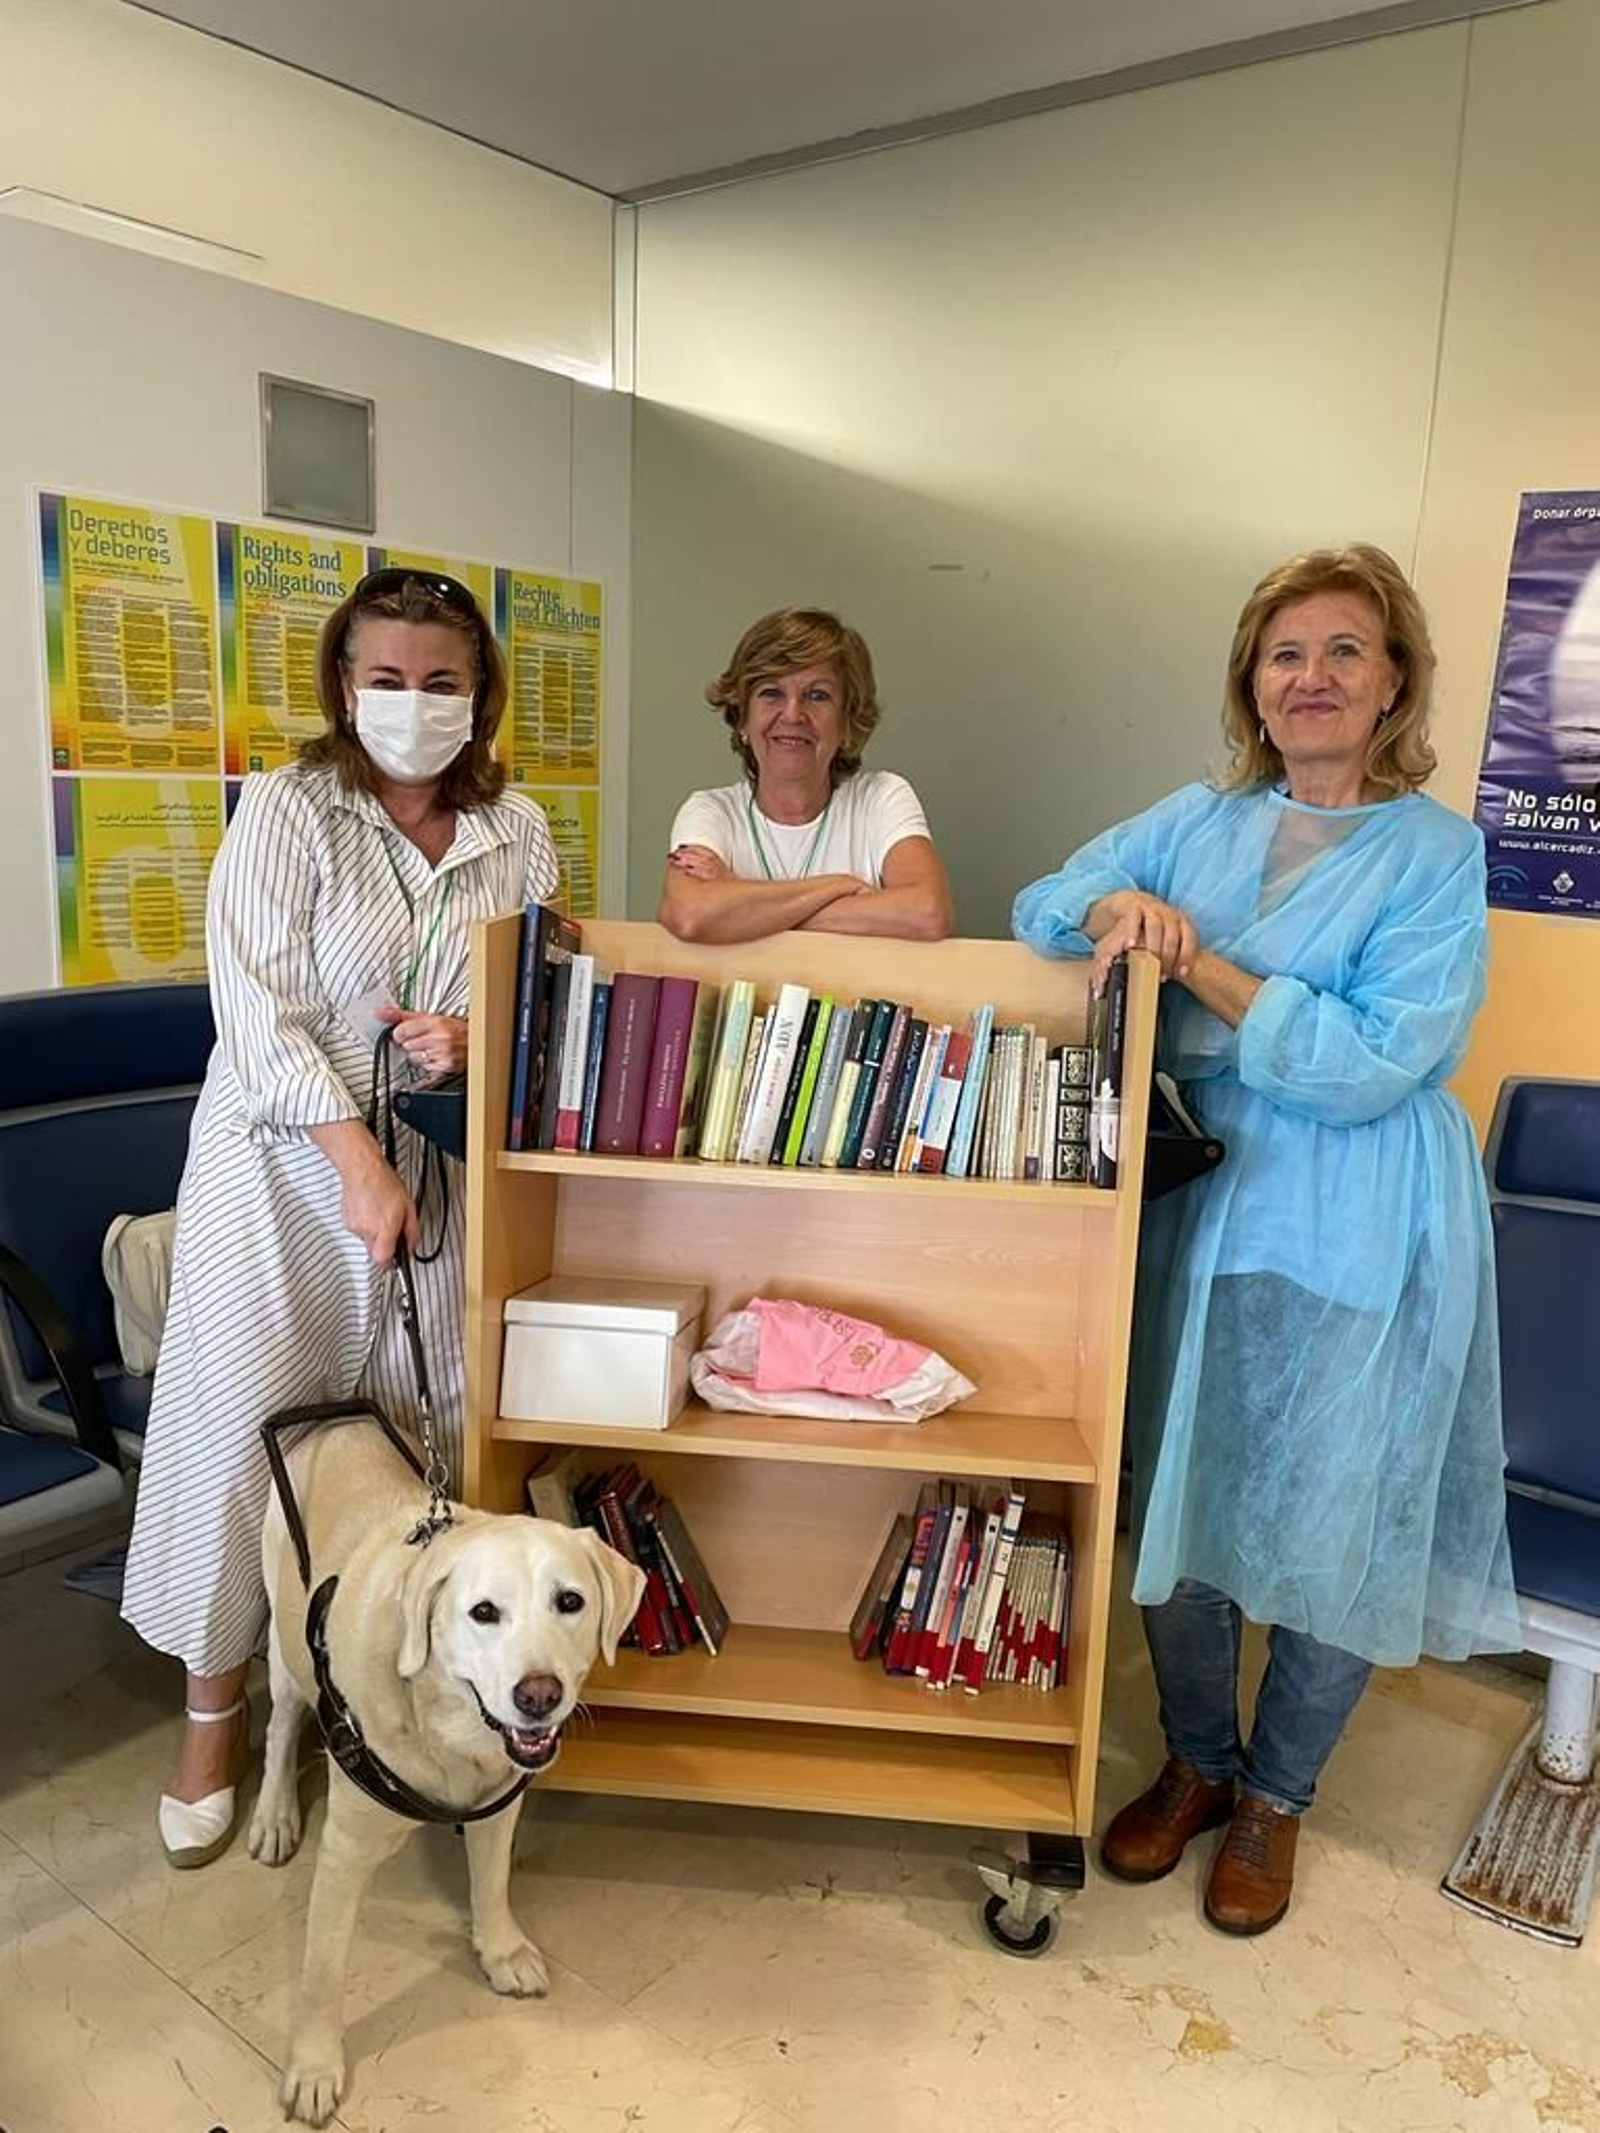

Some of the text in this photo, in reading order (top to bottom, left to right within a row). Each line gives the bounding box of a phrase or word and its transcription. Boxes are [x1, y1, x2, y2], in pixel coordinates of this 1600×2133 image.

[69, 509, 169, 544] Derechos
[86, 534, 171, 565] deberes
[243, 536, 342, 571] Rights and
[244, 564, 347, 599] obligations
[513, 580, 560, 604] Rechte
[513, 603, 600, 629] und Pflichten
[1507, 789, 1596, 813] No sólo
[1503, 811, 1580, 831] salvan
[1499, 840, 1600, 854] www.alcercadiz.
